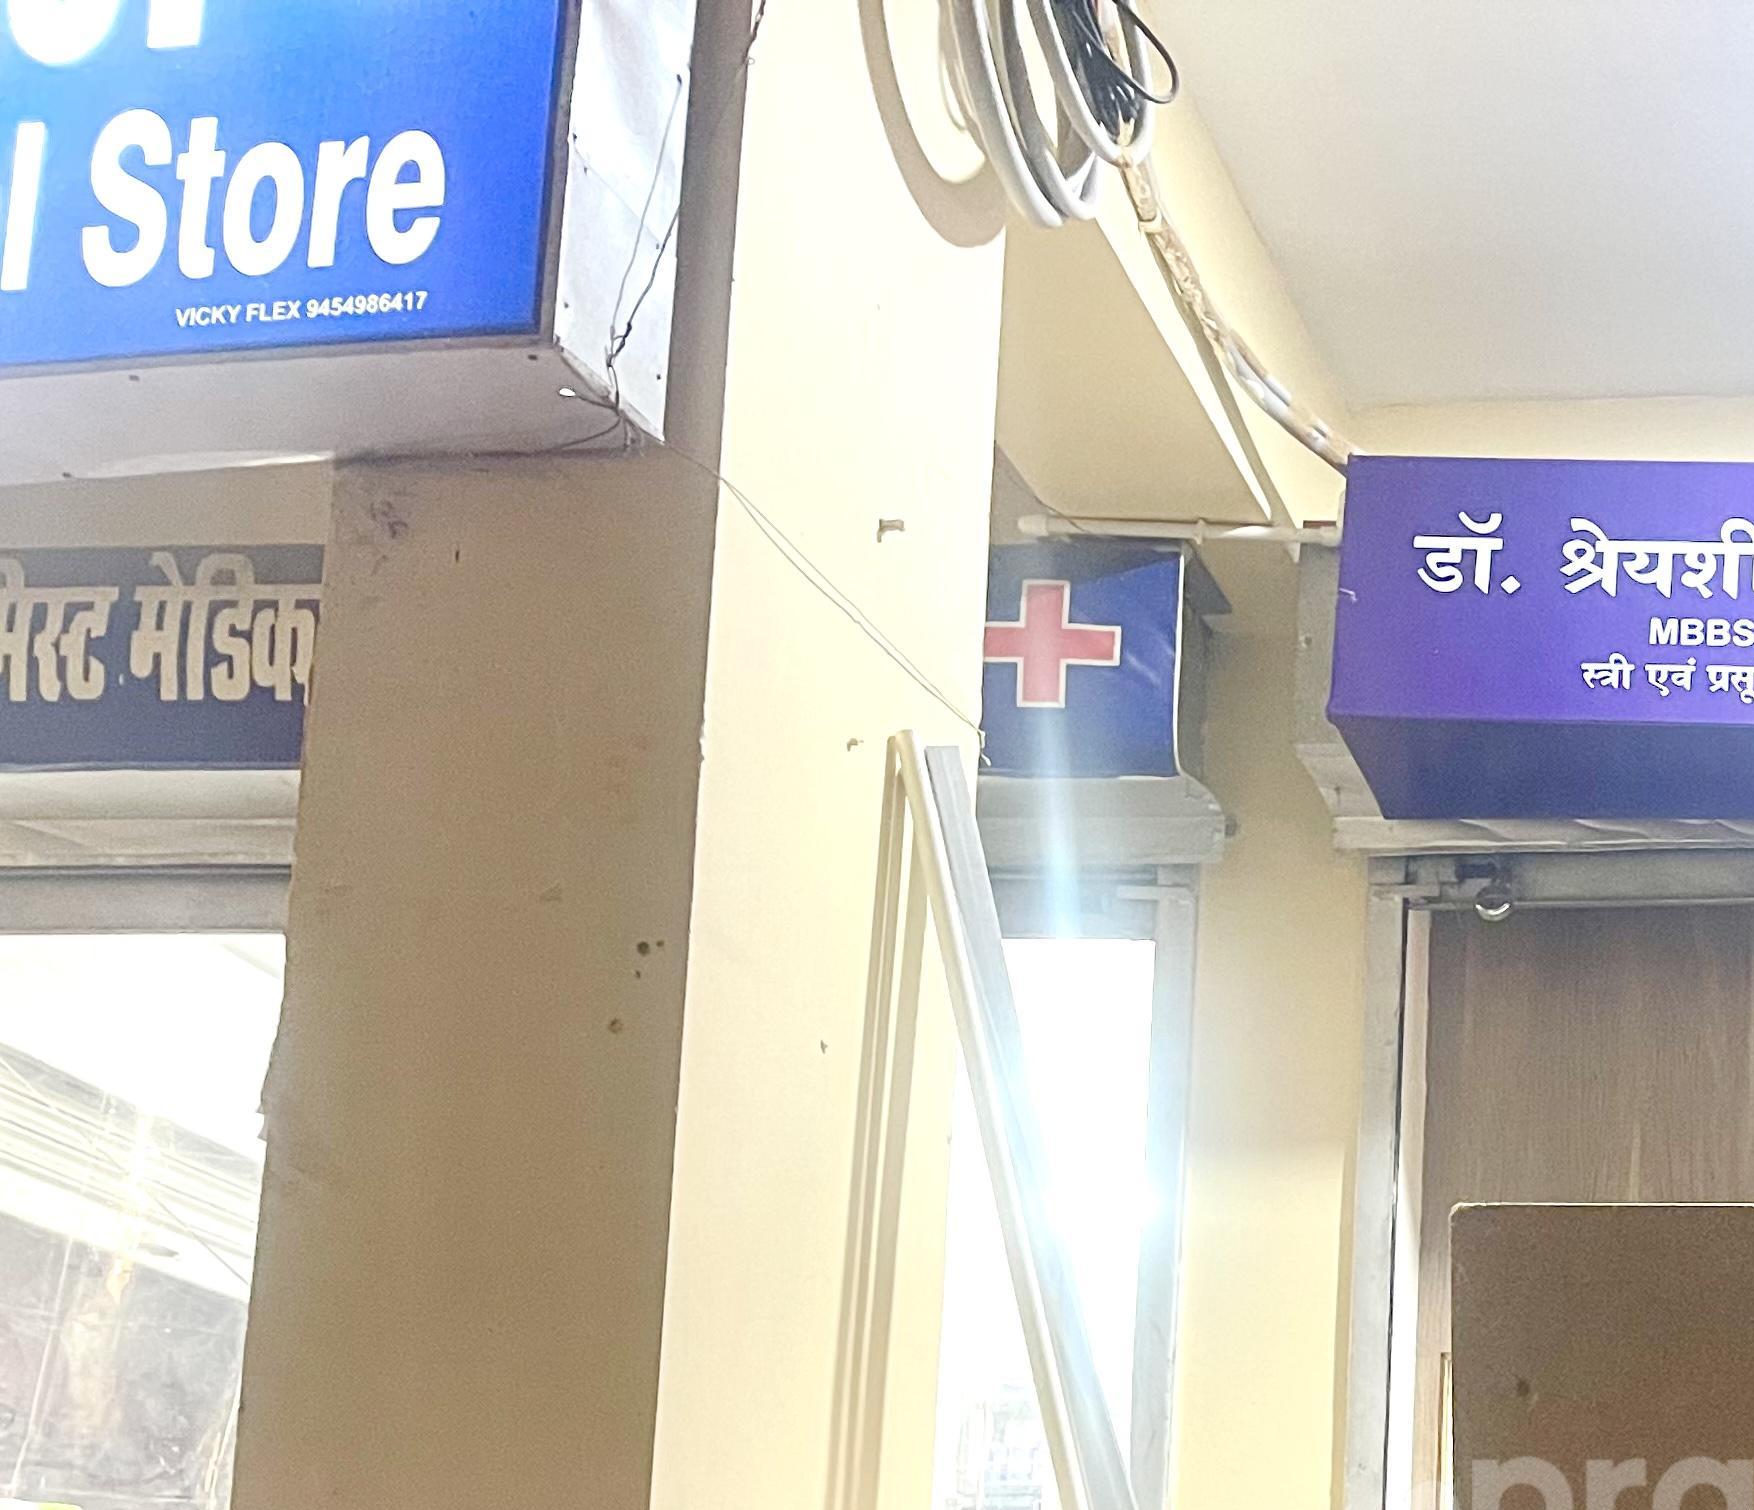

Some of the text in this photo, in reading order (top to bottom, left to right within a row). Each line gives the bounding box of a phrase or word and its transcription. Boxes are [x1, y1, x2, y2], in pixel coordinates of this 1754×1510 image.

[81, 108, 446, 288] Store
[175, 290, 428, 328] VICKY FLEX 9454986417
[1414, 512, 1520, 594] डॉ.
[1581, 653, 1634, 692] स्त्री
[1645, 658, 1696, 696] एवं
